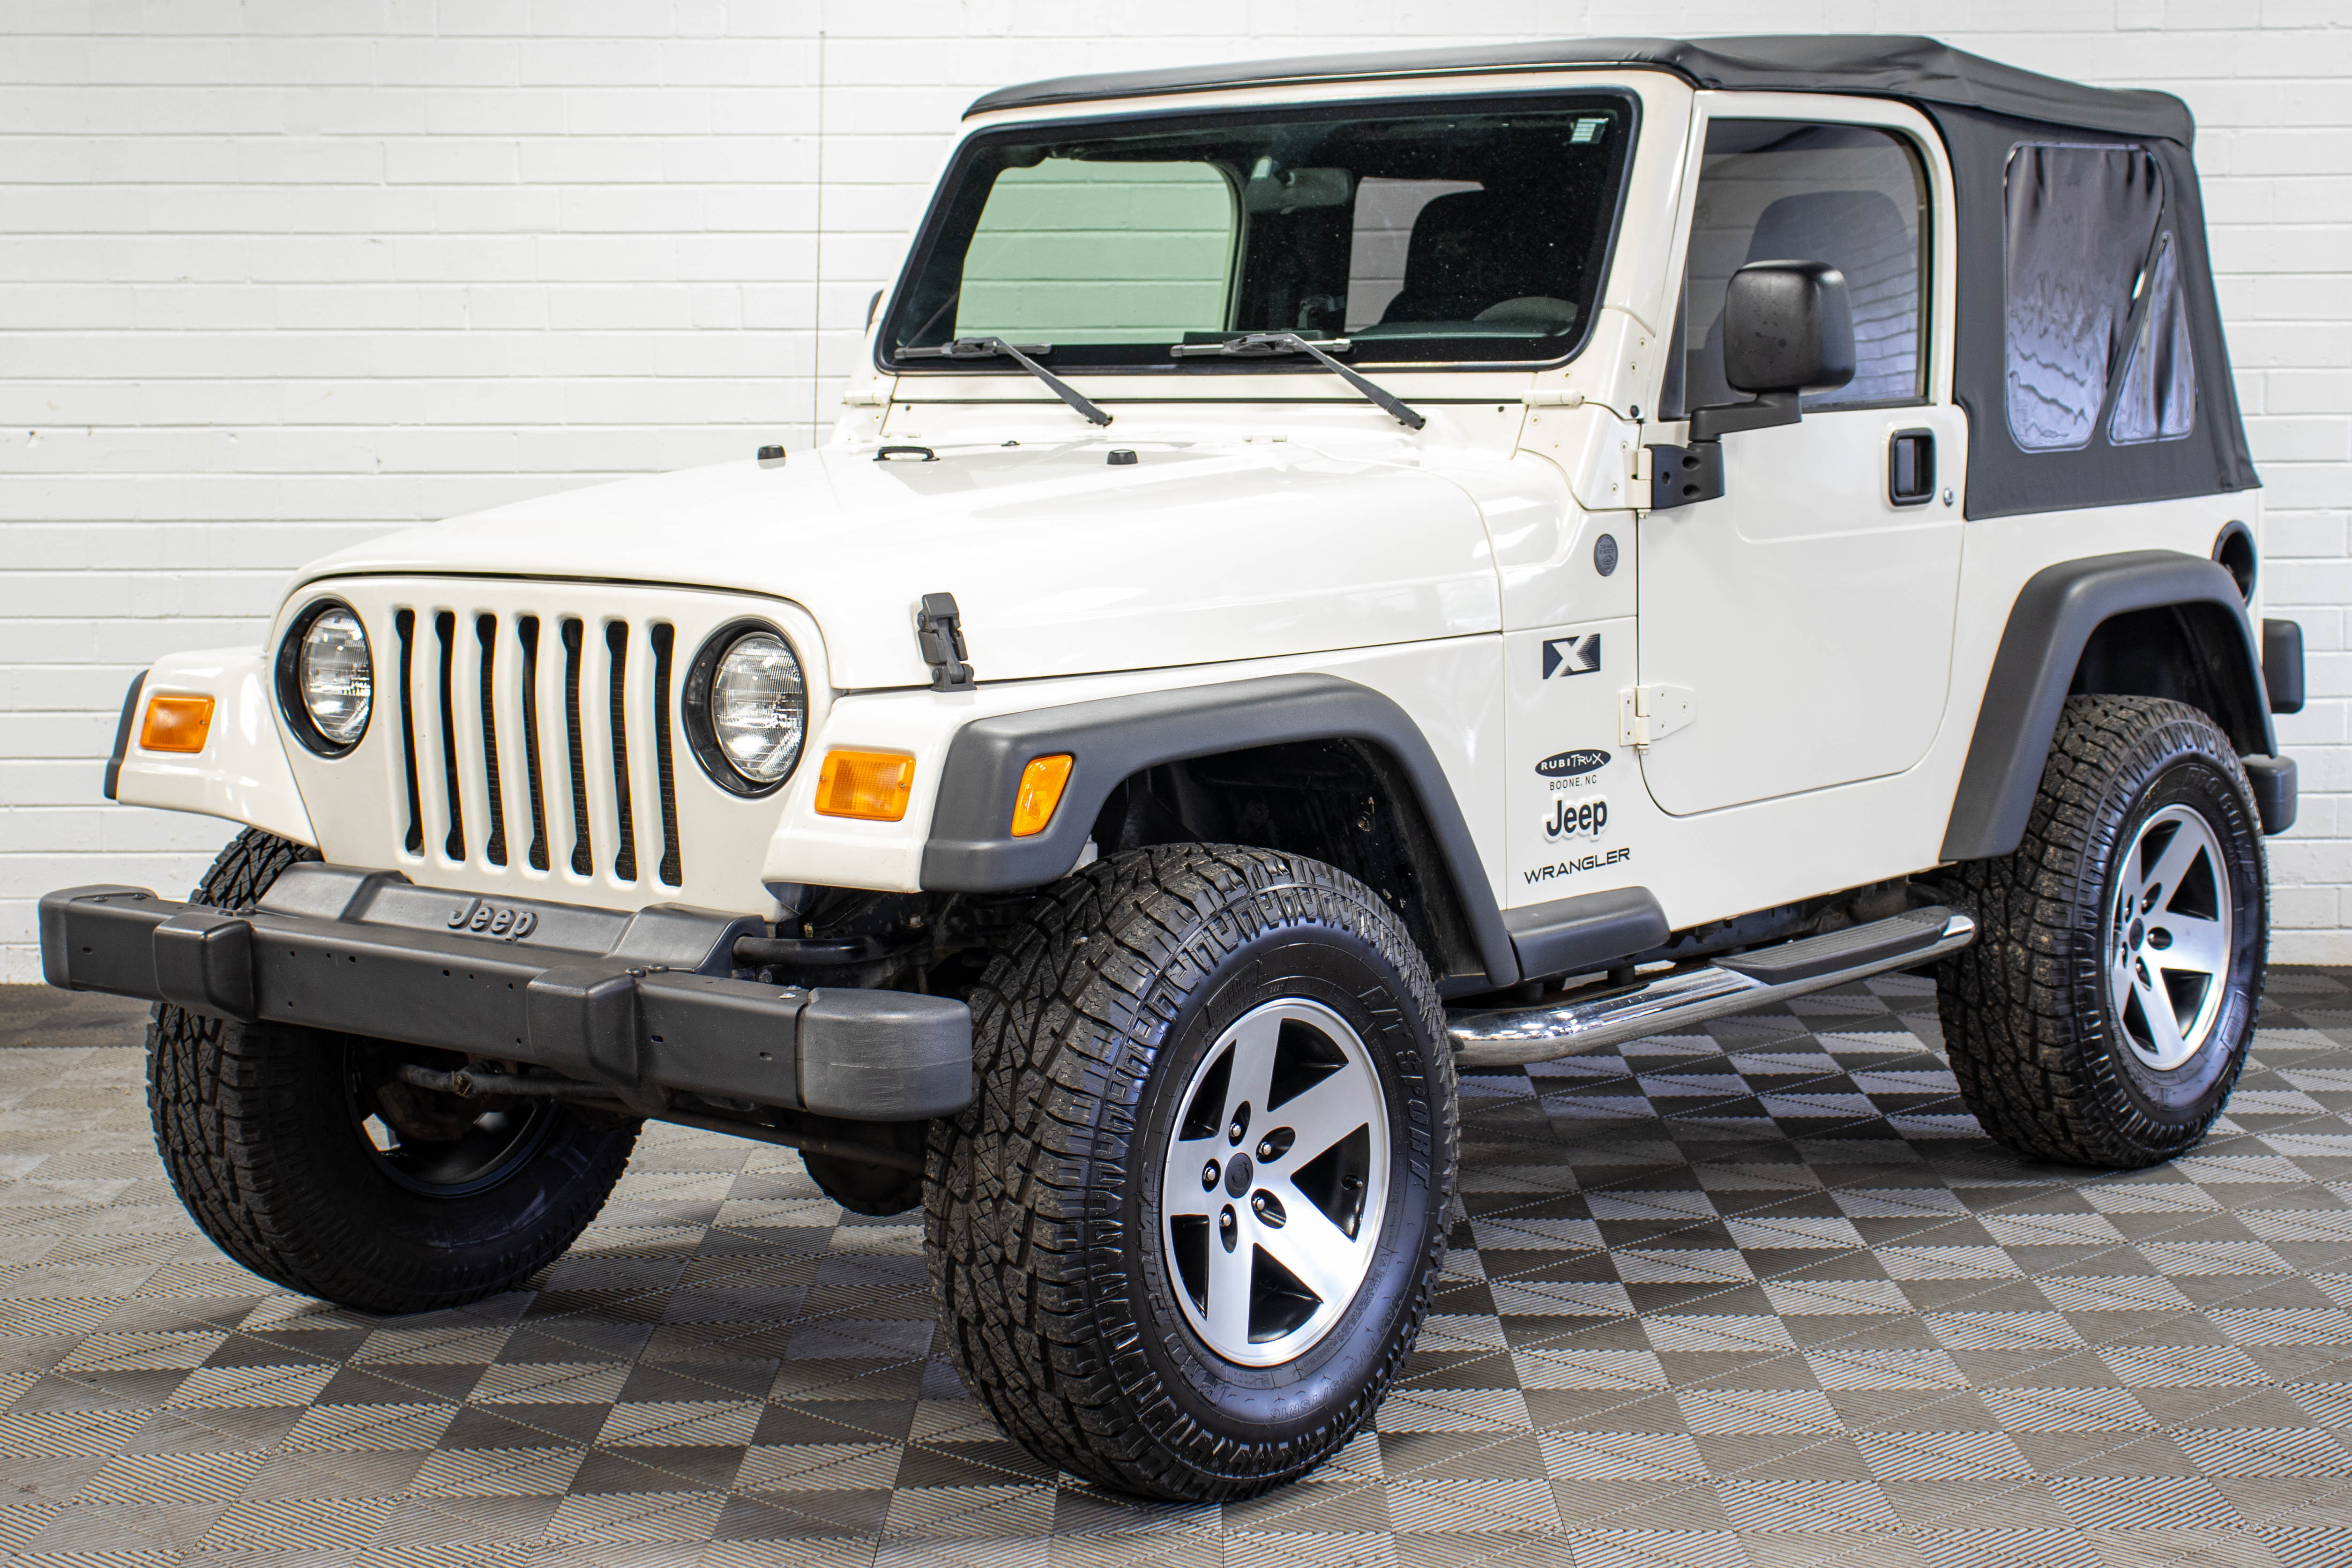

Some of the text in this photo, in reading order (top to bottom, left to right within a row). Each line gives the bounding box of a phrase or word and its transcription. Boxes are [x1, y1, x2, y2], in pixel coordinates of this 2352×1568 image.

[1543, 634, 1600, 679] X
[1550, 774, 1597, 791] BOONE, NC
[1546, 798, 1608, 836] Jeep
[1524, 847, 1631, 885] WRANGLER
[447, 896, 539, 942] Jeep
[1396, 1049, 1431, 1189] SPORT
[1138, 1161, 1172, 1327] COMP
[1164, 1332, 1222, 1407] PRO
[1269, 1337, 1376, 1423] LT265/75R16
